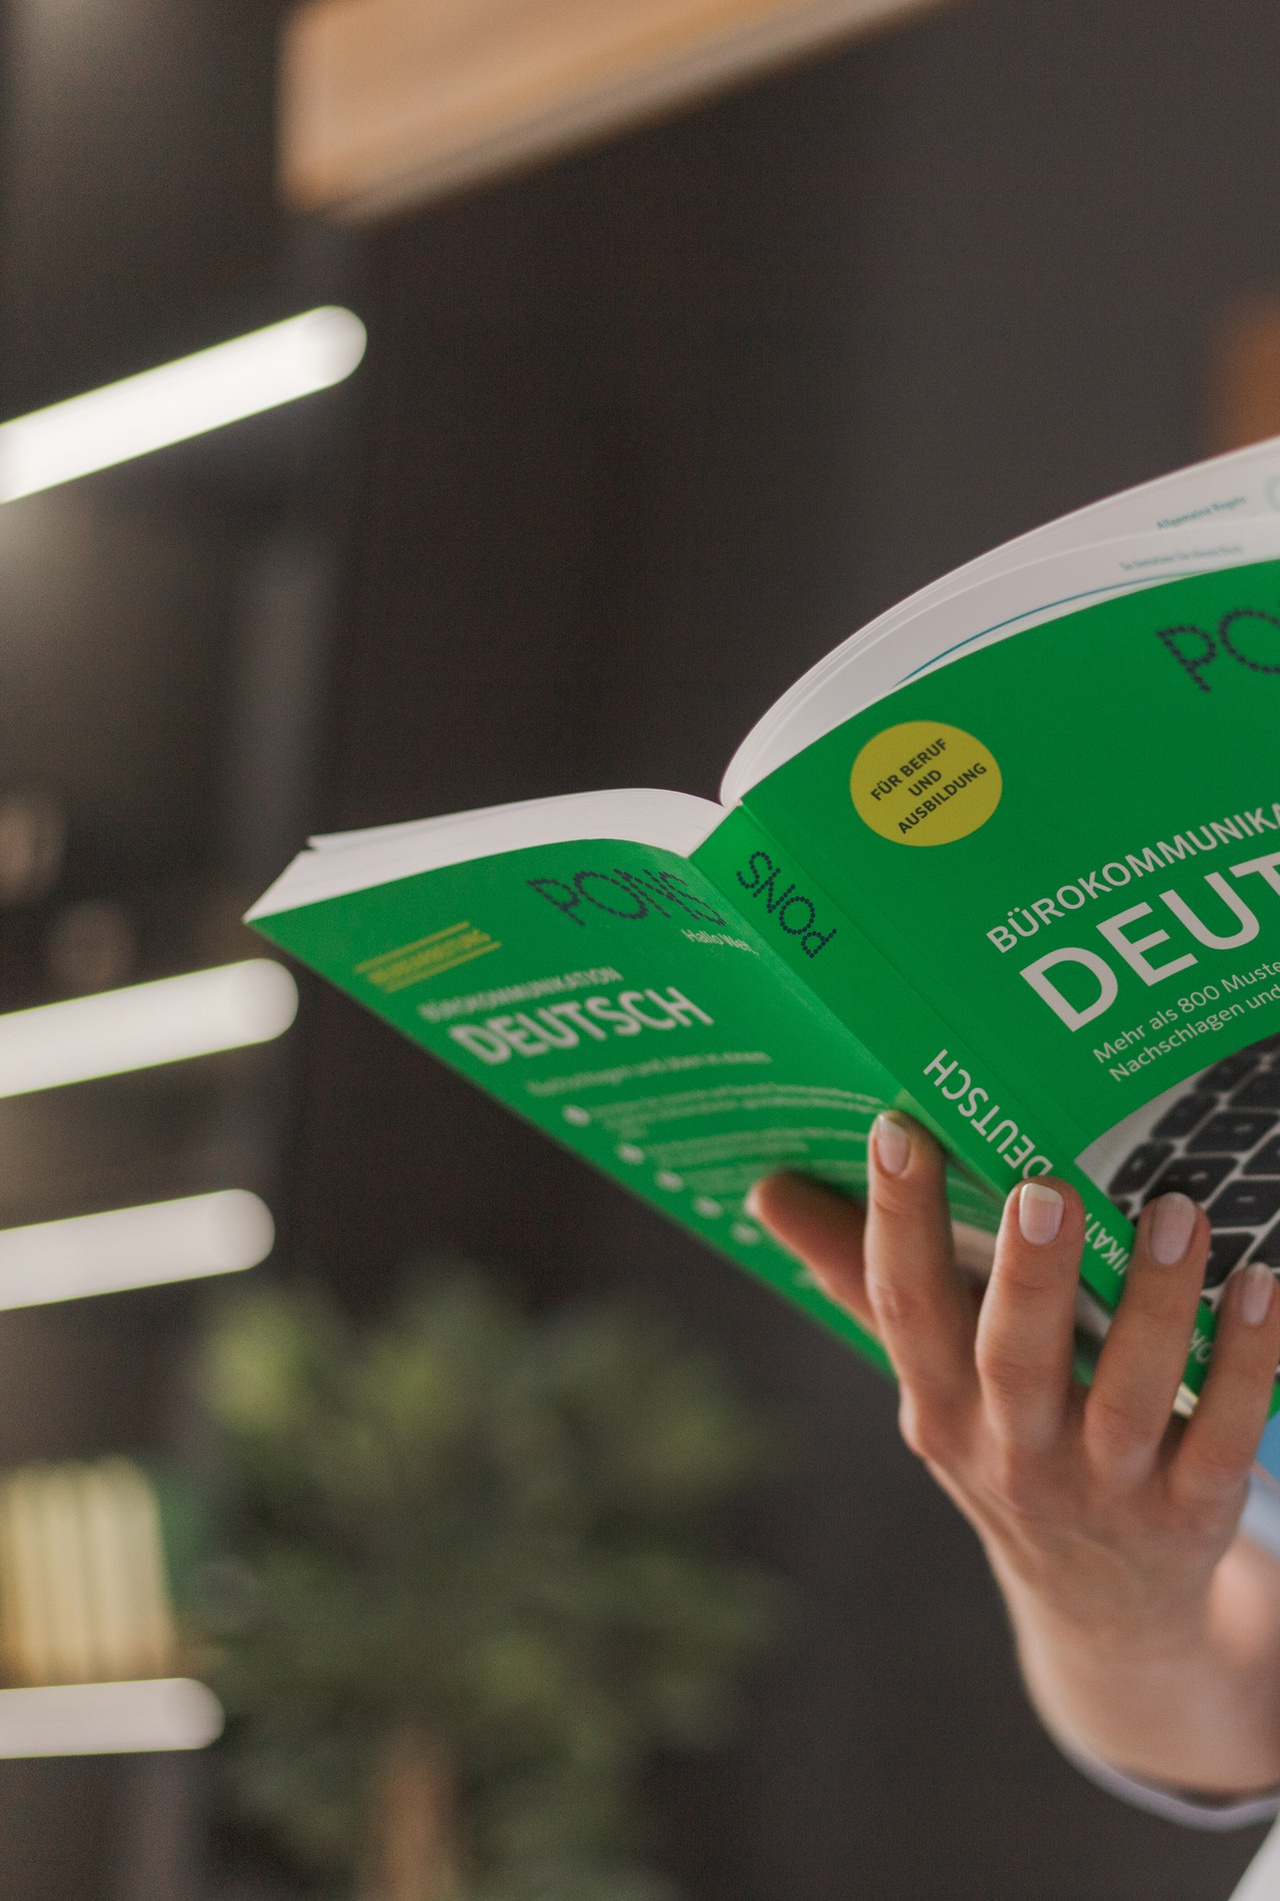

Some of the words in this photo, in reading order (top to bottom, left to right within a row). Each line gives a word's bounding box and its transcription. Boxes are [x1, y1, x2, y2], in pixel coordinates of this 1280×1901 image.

[870, 773, 902, 801] FÜR
[899, 738, 948, 778] BERUF
[897, 762, 987, 834] AUSBILDUNG
[907, 769, 942, 798] UND
[526, 868, 728, 926] PONS
[736, 851, 837, 958] PONS
[448, 986, 714, 1065] DEUTSCH
[1093, 1025, 1145, 1063] Mehr
[1148, 1004, 1178, 1032] als
[1177, 984, 1221, 1014] 800
[1108, 1002, 1245, 1082] Nachschlagen
[923, 1049, 1053, 1179] DEUTSCH
